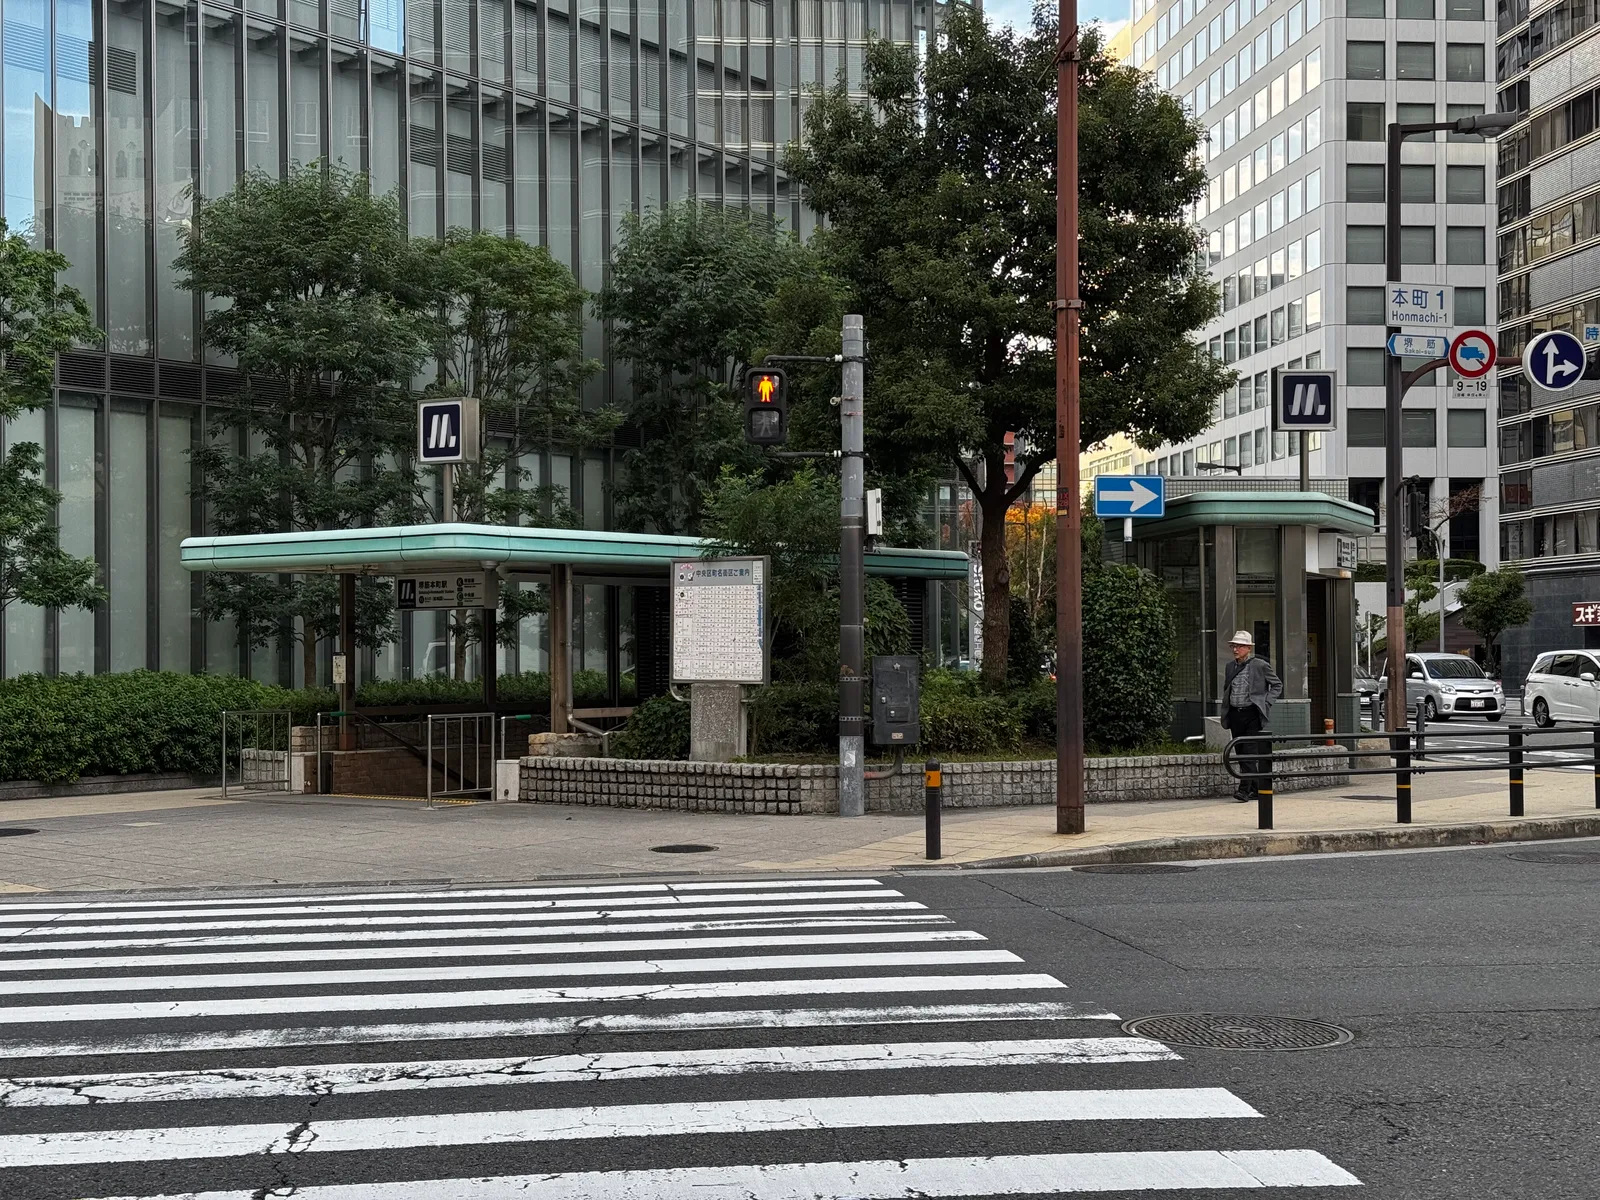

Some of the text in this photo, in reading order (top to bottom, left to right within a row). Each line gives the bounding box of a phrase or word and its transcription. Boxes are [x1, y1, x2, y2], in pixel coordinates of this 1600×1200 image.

[1391, 310, 1448, 324] Honmachi-1
[1586, 327, 1600, 340] 時
[695, 568, 750, 578] 中央区町名街区ご案内
[418, 580, 448, 589] 堺筋本町駅
